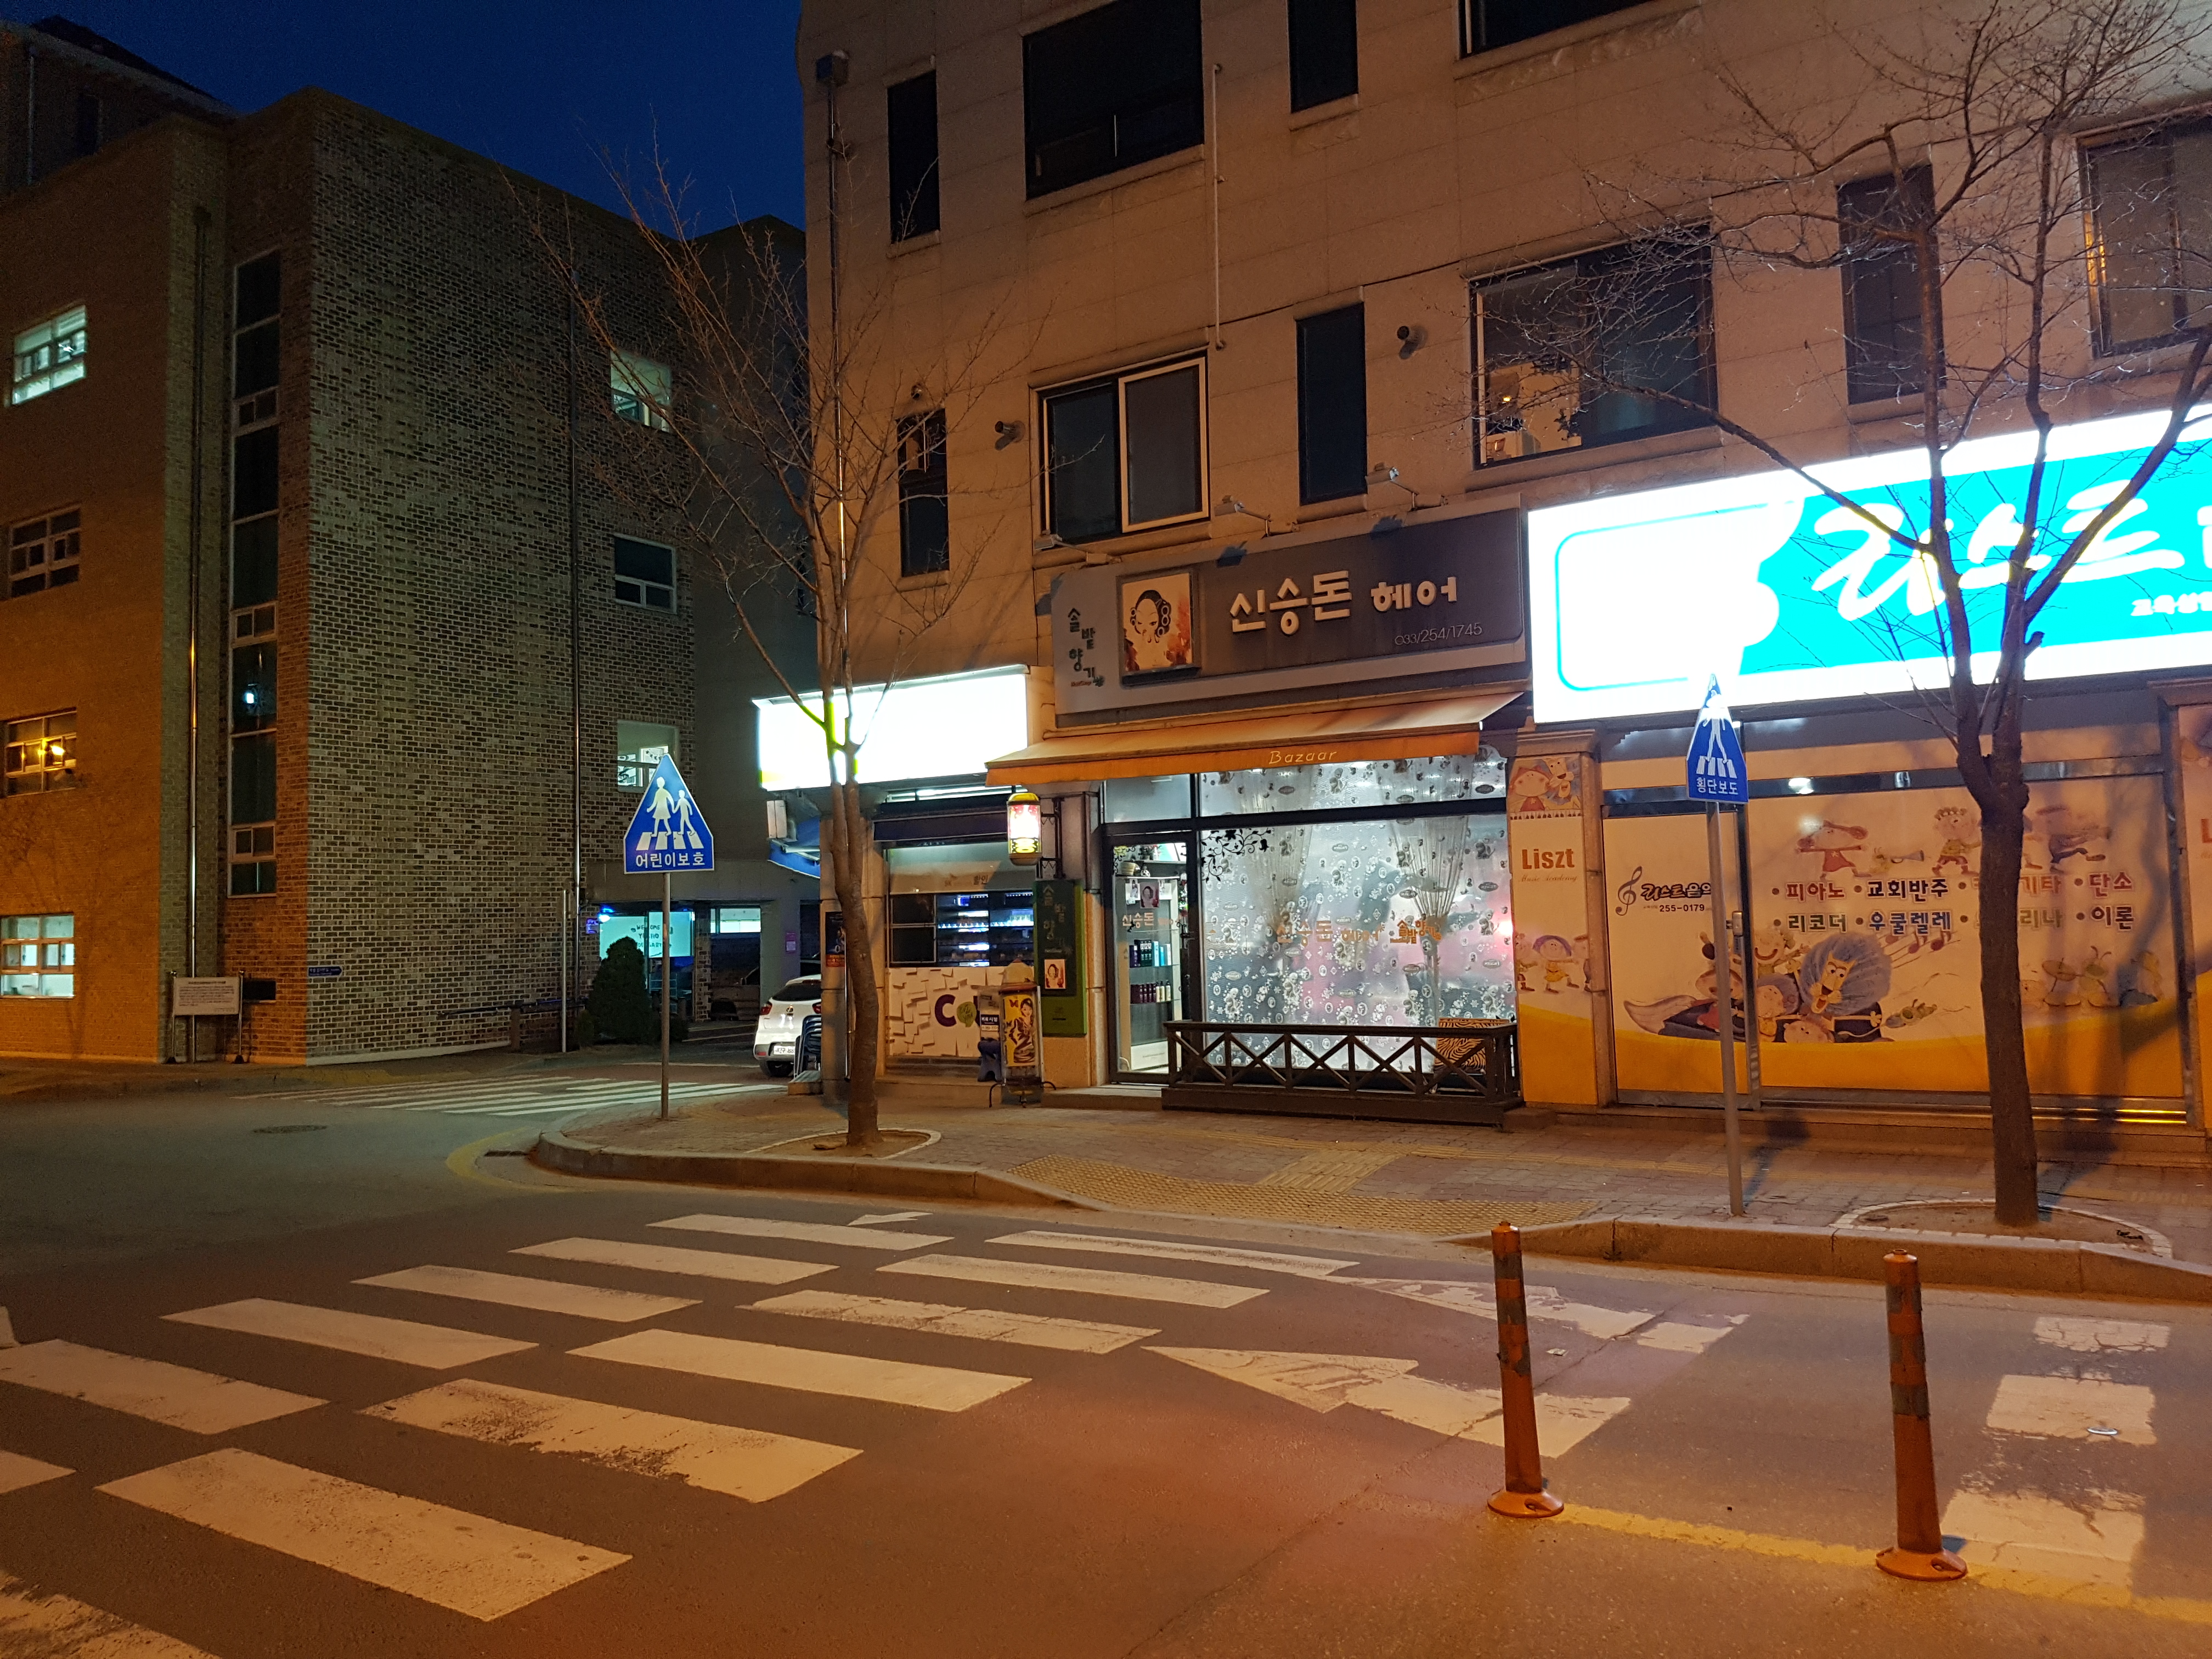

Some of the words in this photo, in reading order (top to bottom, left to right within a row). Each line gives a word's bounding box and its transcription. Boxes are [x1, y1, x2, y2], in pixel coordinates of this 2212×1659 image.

[1229, 570, 1352, 635] 신승돈
[1371, 576, 1457, 612] 헤어
[1268, 751, 1337, 764] Bazaar
[1696, 777, 1739, 795] 횡단보도
[635, 851, 706, 868] 어린이보호
[1522, 849, 1575, 870] Liszt
[1786, 882, 1845, 901] 피아노
[1867, 878, 1948, 902] 교회반주
[2090, 872, 2133, 897] 단소
[1660, 904, 1705, 912] 255-0179
[1122, 912, 1154, 928] 신승돈
[1788, 913, 1847, 932] 리코더
[1869, 911, 1951, 935] 우쿨렐레
[2091, 906, 2134, 930] 이론
